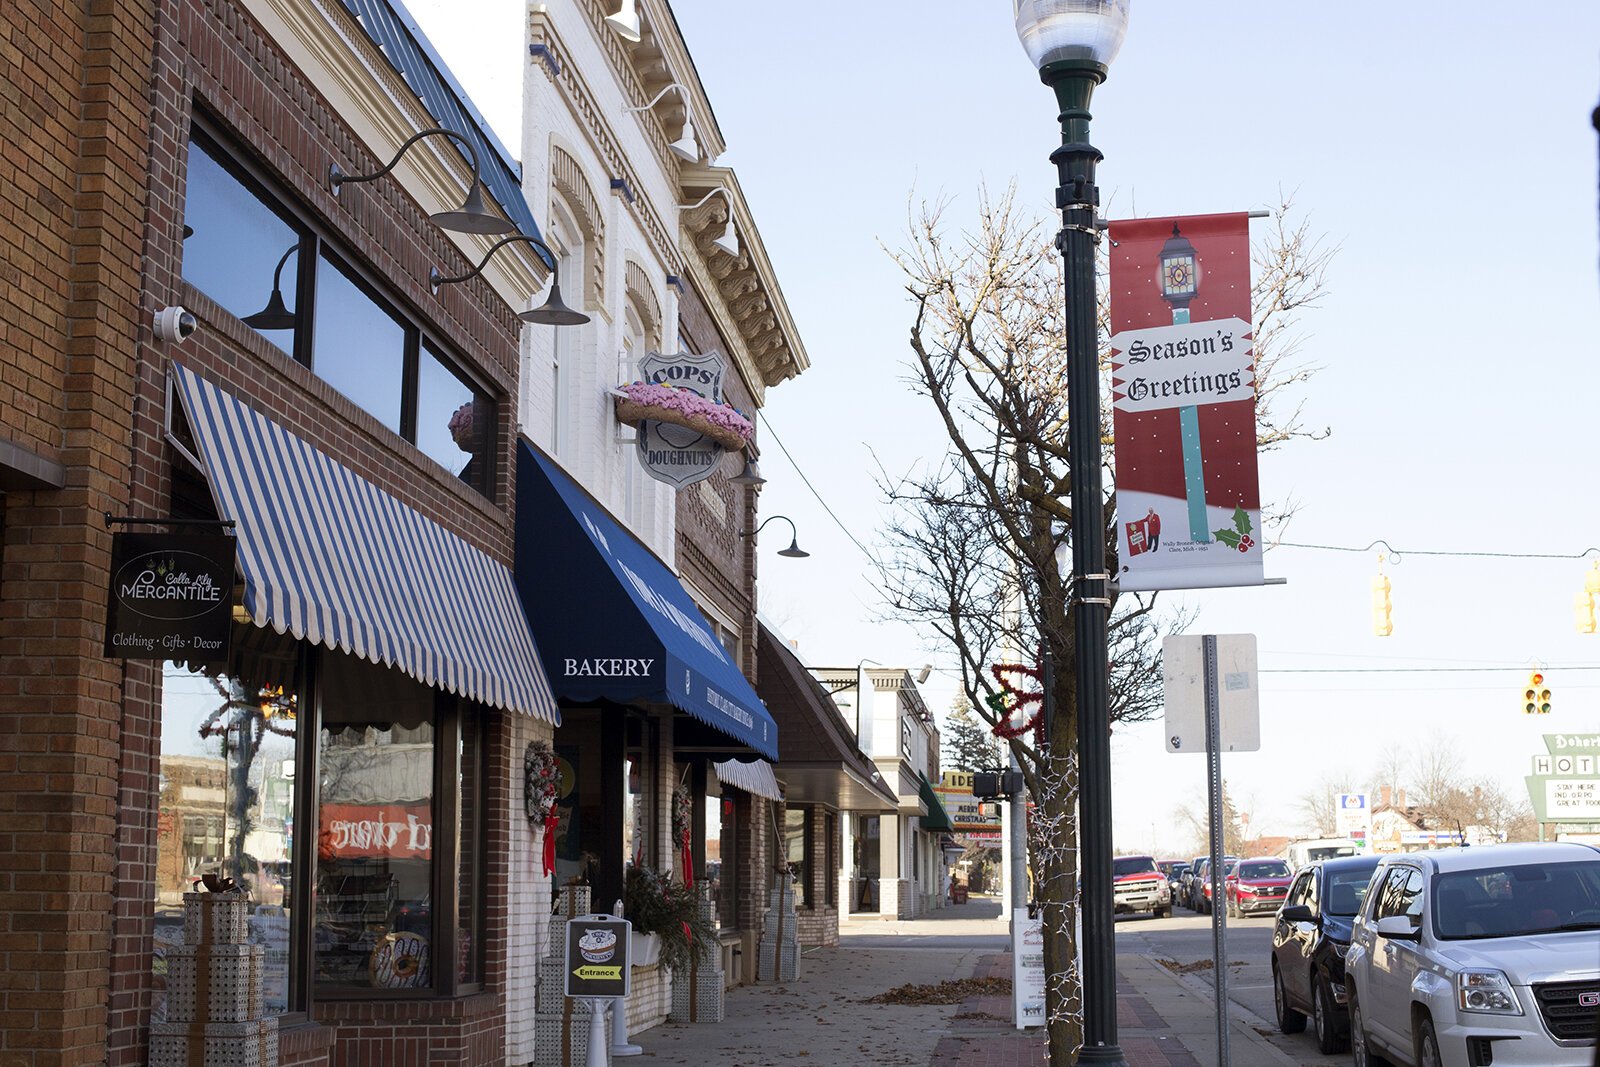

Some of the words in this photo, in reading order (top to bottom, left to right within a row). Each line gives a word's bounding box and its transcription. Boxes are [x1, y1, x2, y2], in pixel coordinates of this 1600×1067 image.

[1128, 330, 1233, 365] Season's
[652, 365, 715, 385] COPS
[1127, 369, 1241, 402] Greetings
[648, 450, 714, 466] DOUGHNUTS
[121, 573, 221, 601] MERCANTILE
[165, 572, 191, 585] Calla
[191, 573, 212, 592] Lily
[112, 632, 155, 651] Clothing
[162, 633, 186, 652] Gifts
[193, 636, 222, 649] Decor
[563, 658, 654, 677] BAKERY
[1538, 758, 1590, 772] HOT
[951, 775, 973, 787] IDE
[957, 805, 978, 813] MERRY
[953, 815, 987, 823] CHRISTMAS
